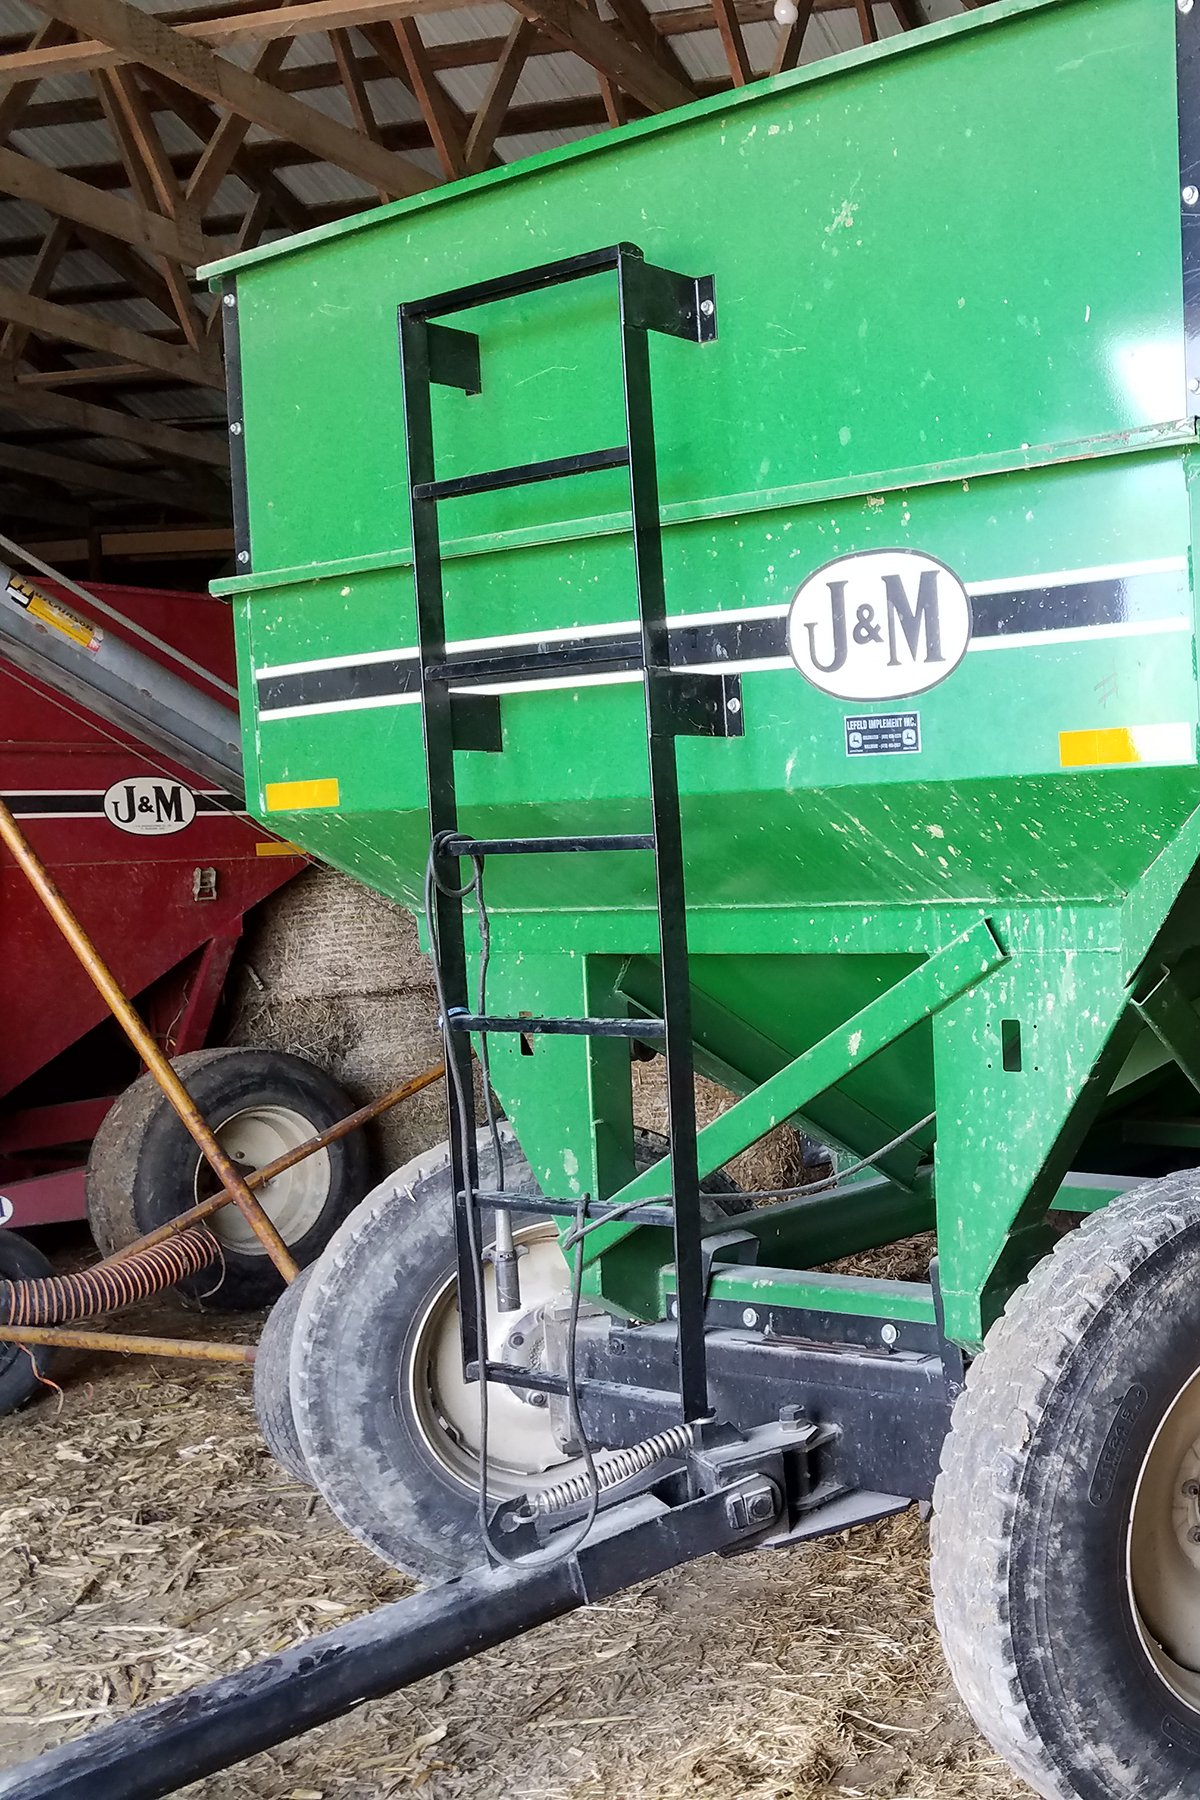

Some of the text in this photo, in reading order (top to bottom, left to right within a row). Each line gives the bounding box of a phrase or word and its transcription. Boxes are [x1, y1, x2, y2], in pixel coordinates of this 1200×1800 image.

[804, 570, 946, 673] J&M
[847, 719, 868, 731] LEFELD
[868, 717, 903, 729] IMPLEMENT
[111, 785, 186, 823] J&M
